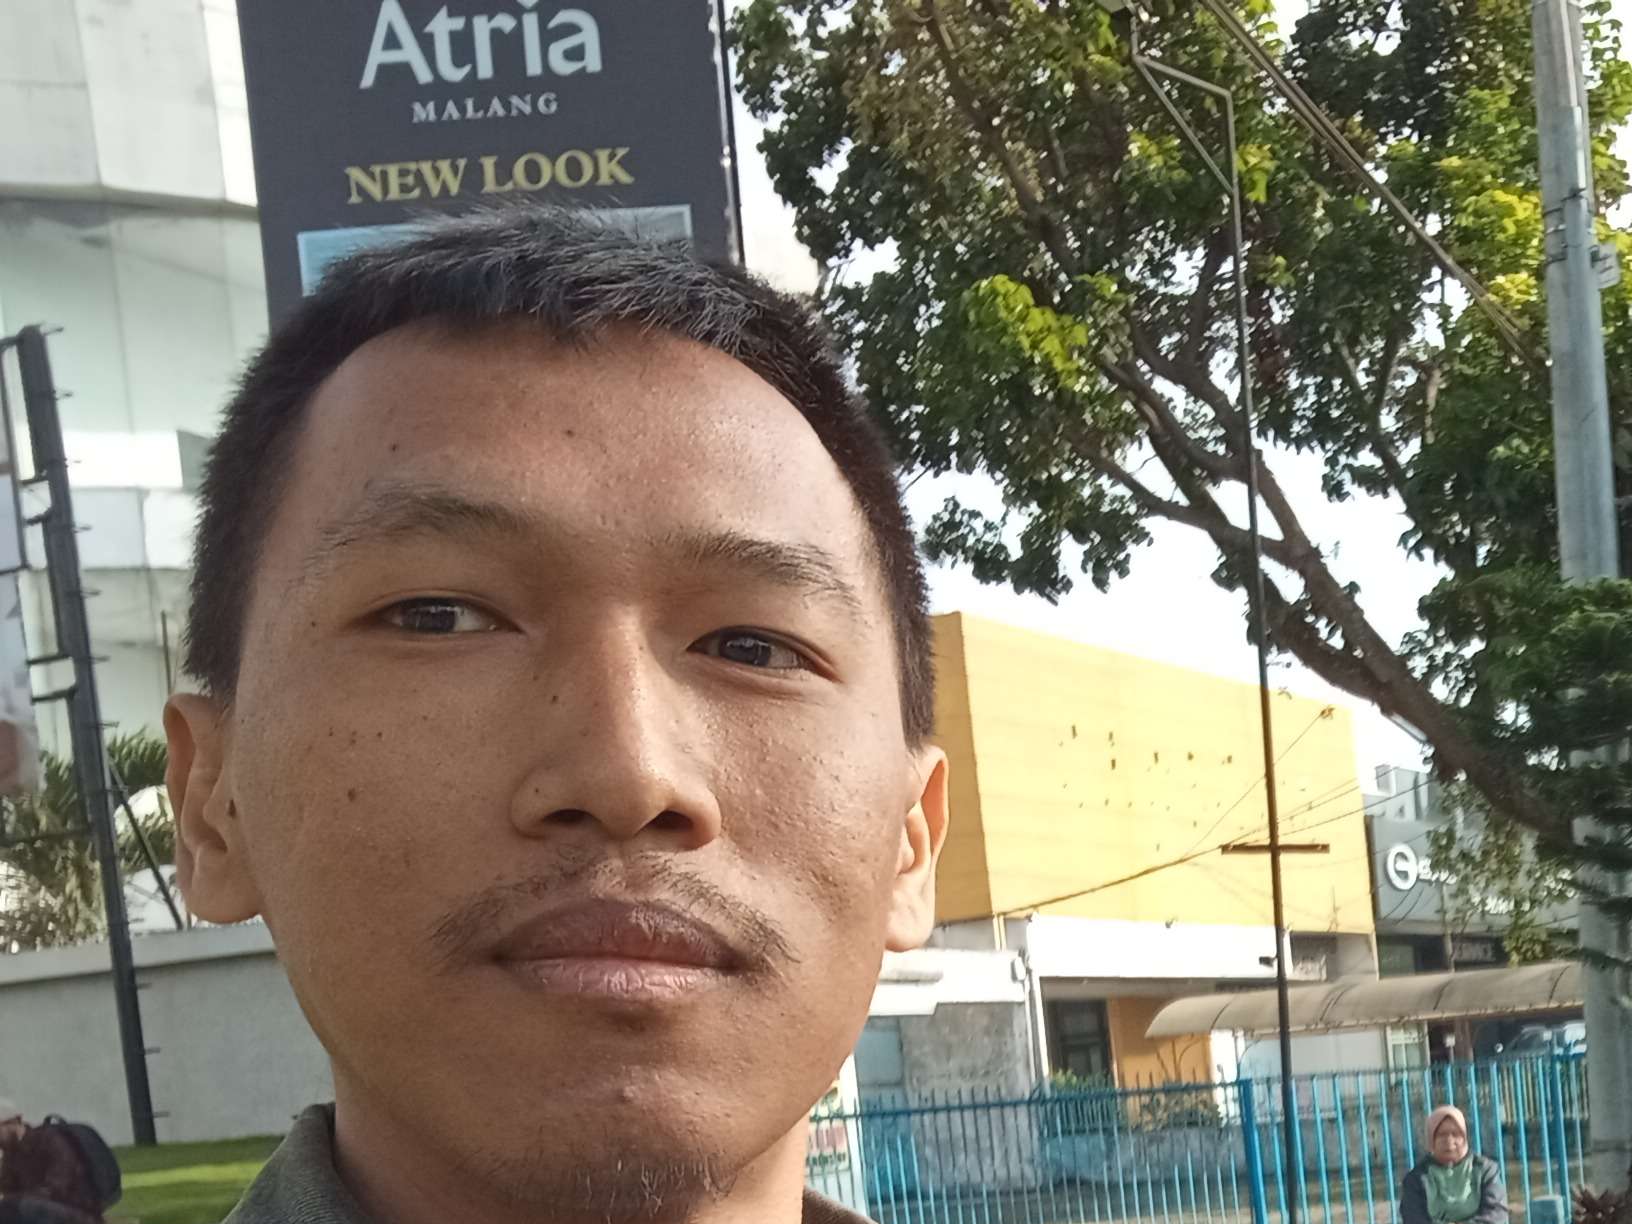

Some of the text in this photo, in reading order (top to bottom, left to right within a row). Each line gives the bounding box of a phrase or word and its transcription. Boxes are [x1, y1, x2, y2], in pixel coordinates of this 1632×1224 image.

[359, 0, 602, 90] Atria
[411, 92, 559, 123] MALANG
[345, 147, 635, 205] NEW LOOK
